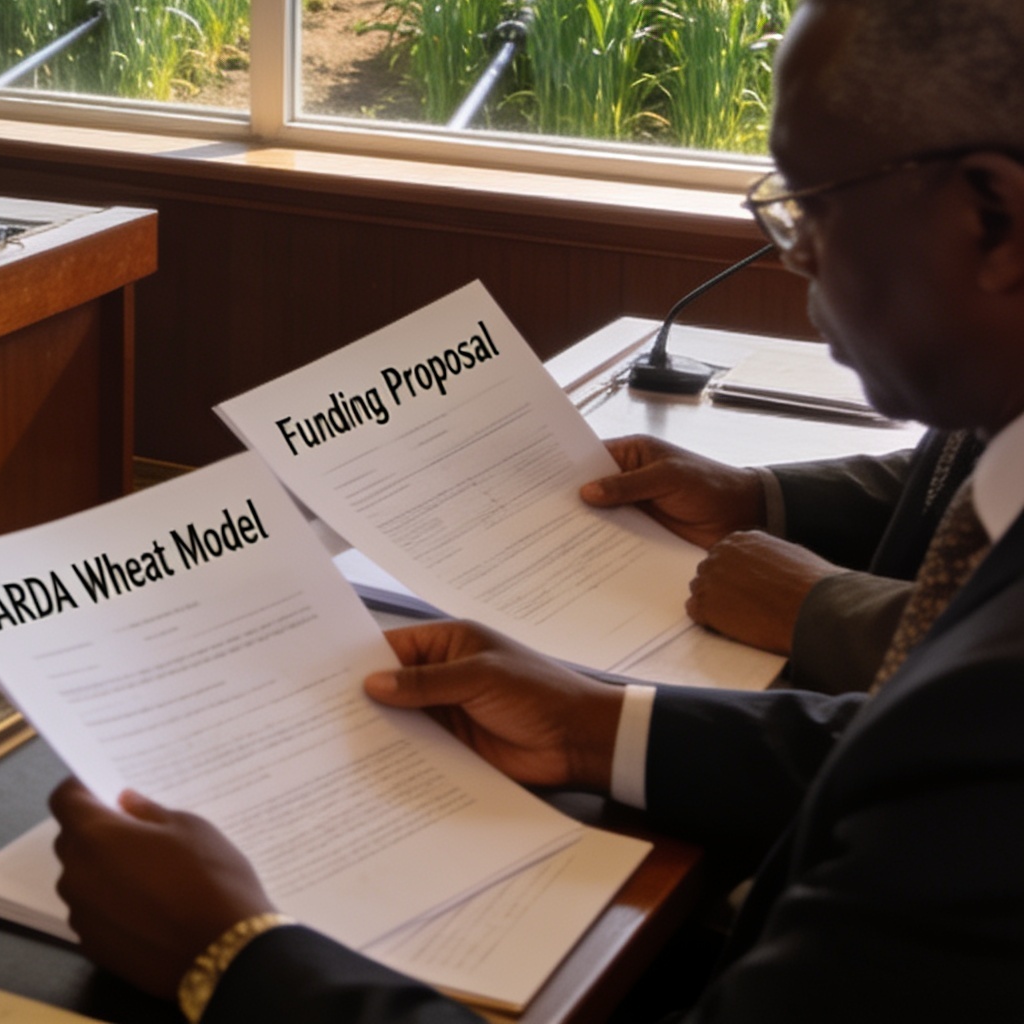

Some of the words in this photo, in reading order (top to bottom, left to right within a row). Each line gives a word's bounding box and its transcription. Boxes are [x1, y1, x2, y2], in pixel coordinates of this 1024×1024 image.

[275, 387, 390, 456] Funding
[380, 320, 500, 406] Proposal
[71, 540, 175, 604] Wheat
[169, 498, 269, 570] Model
